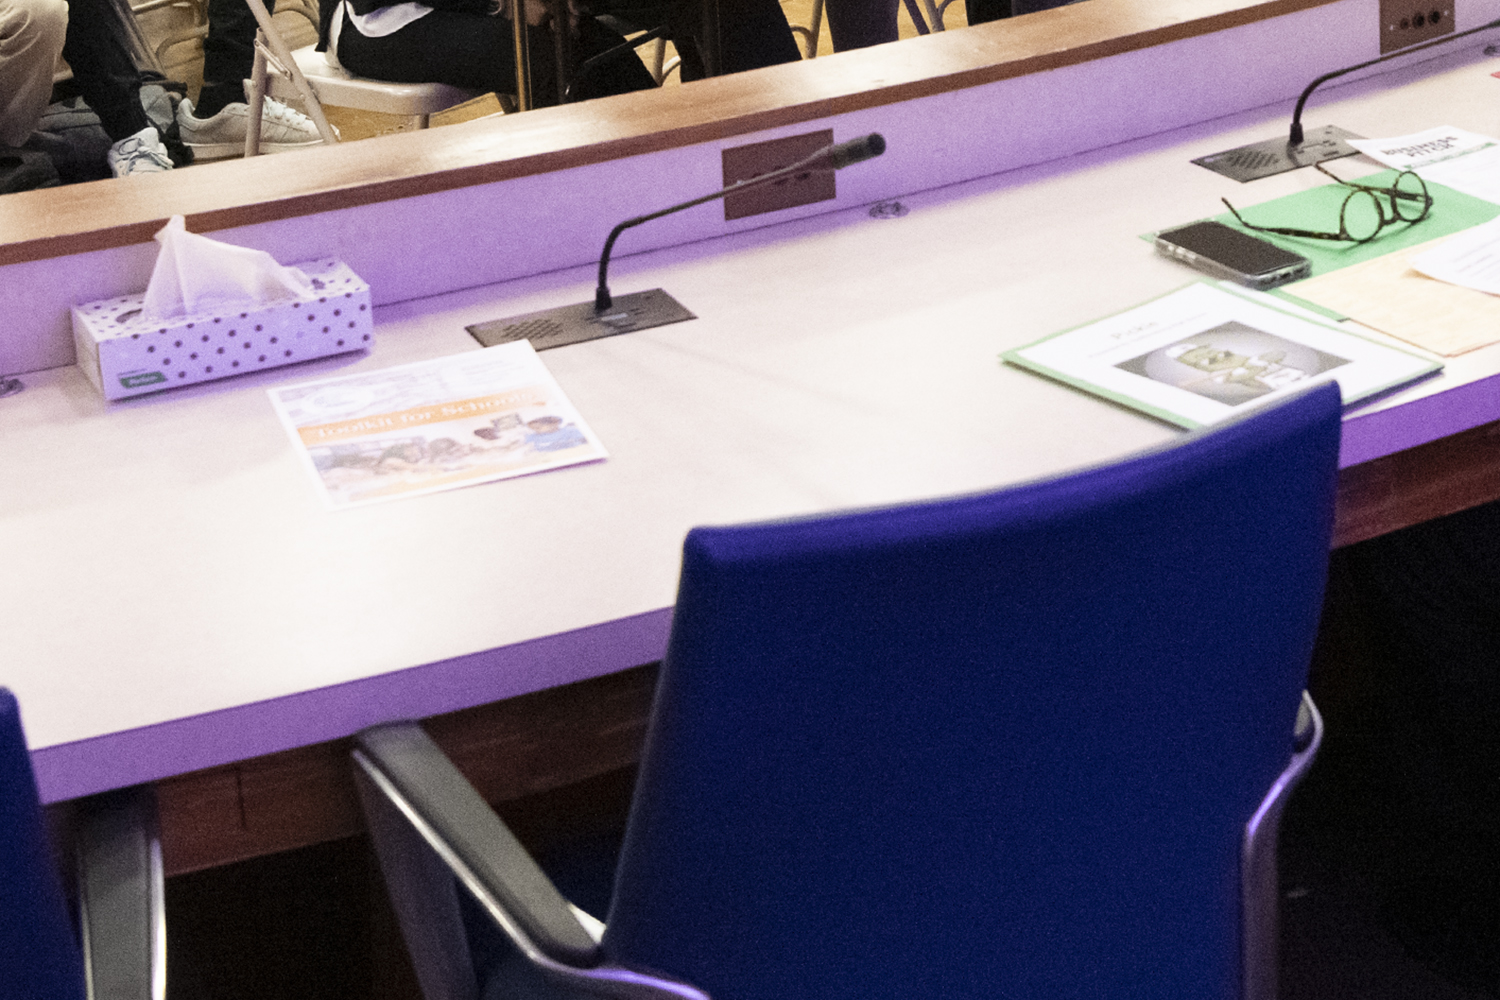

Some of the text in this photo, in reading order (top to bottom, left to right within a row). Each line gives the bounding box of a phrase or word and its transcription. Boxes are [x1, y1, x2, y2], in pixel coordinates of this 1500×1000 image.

[1380, 136, 1459, 155] BUSINESS
[317, 393, 535, 438] Toolkit for Schools
